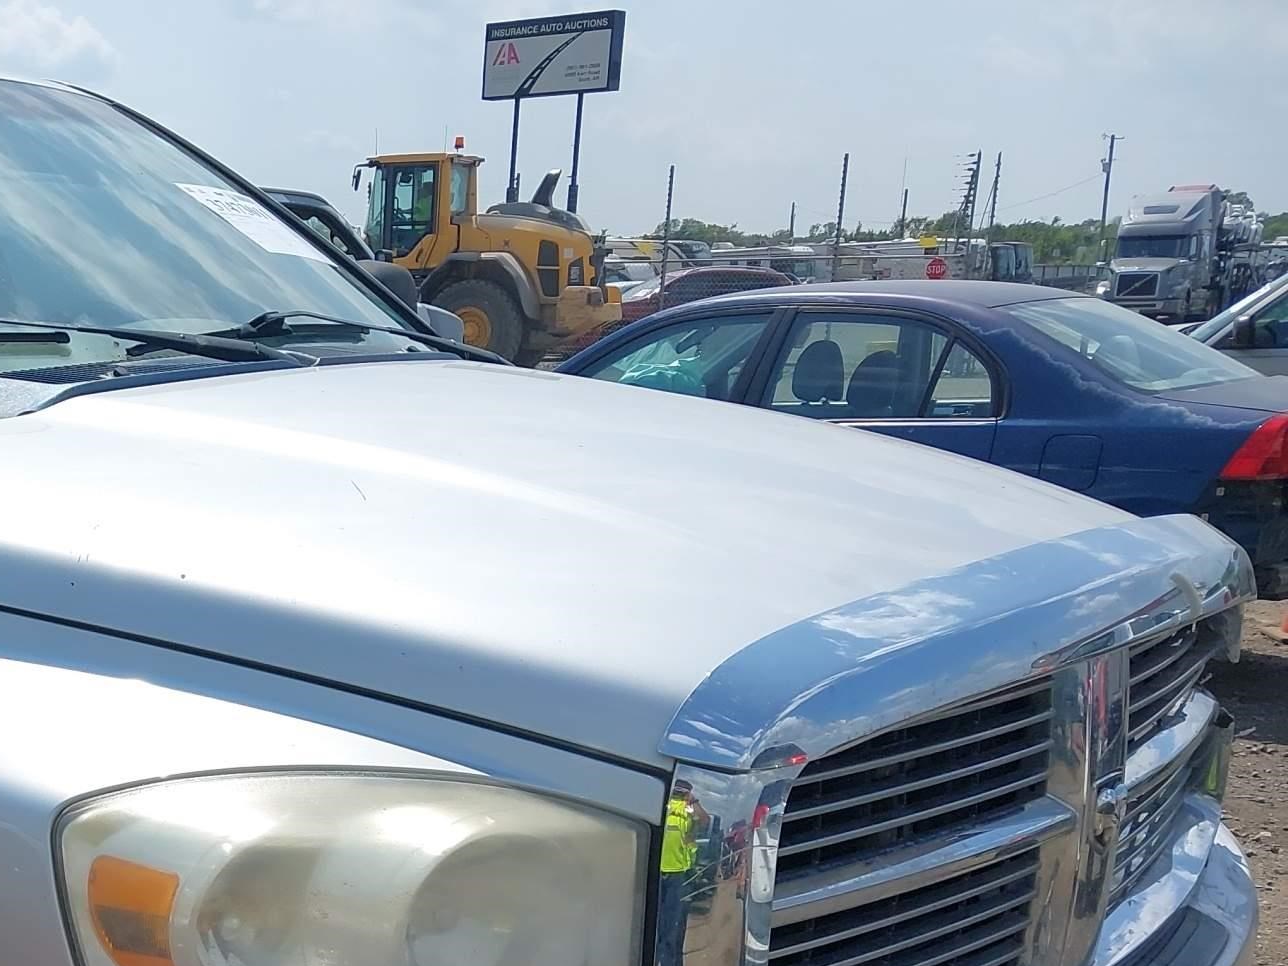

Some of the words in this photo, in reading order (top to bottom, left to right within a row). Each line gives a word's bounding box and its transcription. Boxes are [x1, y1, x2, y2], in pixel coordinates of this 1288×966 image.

[491, 25, 538, 38] INSURANCE
[540, 22, 563, 32] AUTO
[564, 18, 609, 30] AUCTIONS
[927, 264, 946, 275] STOP
